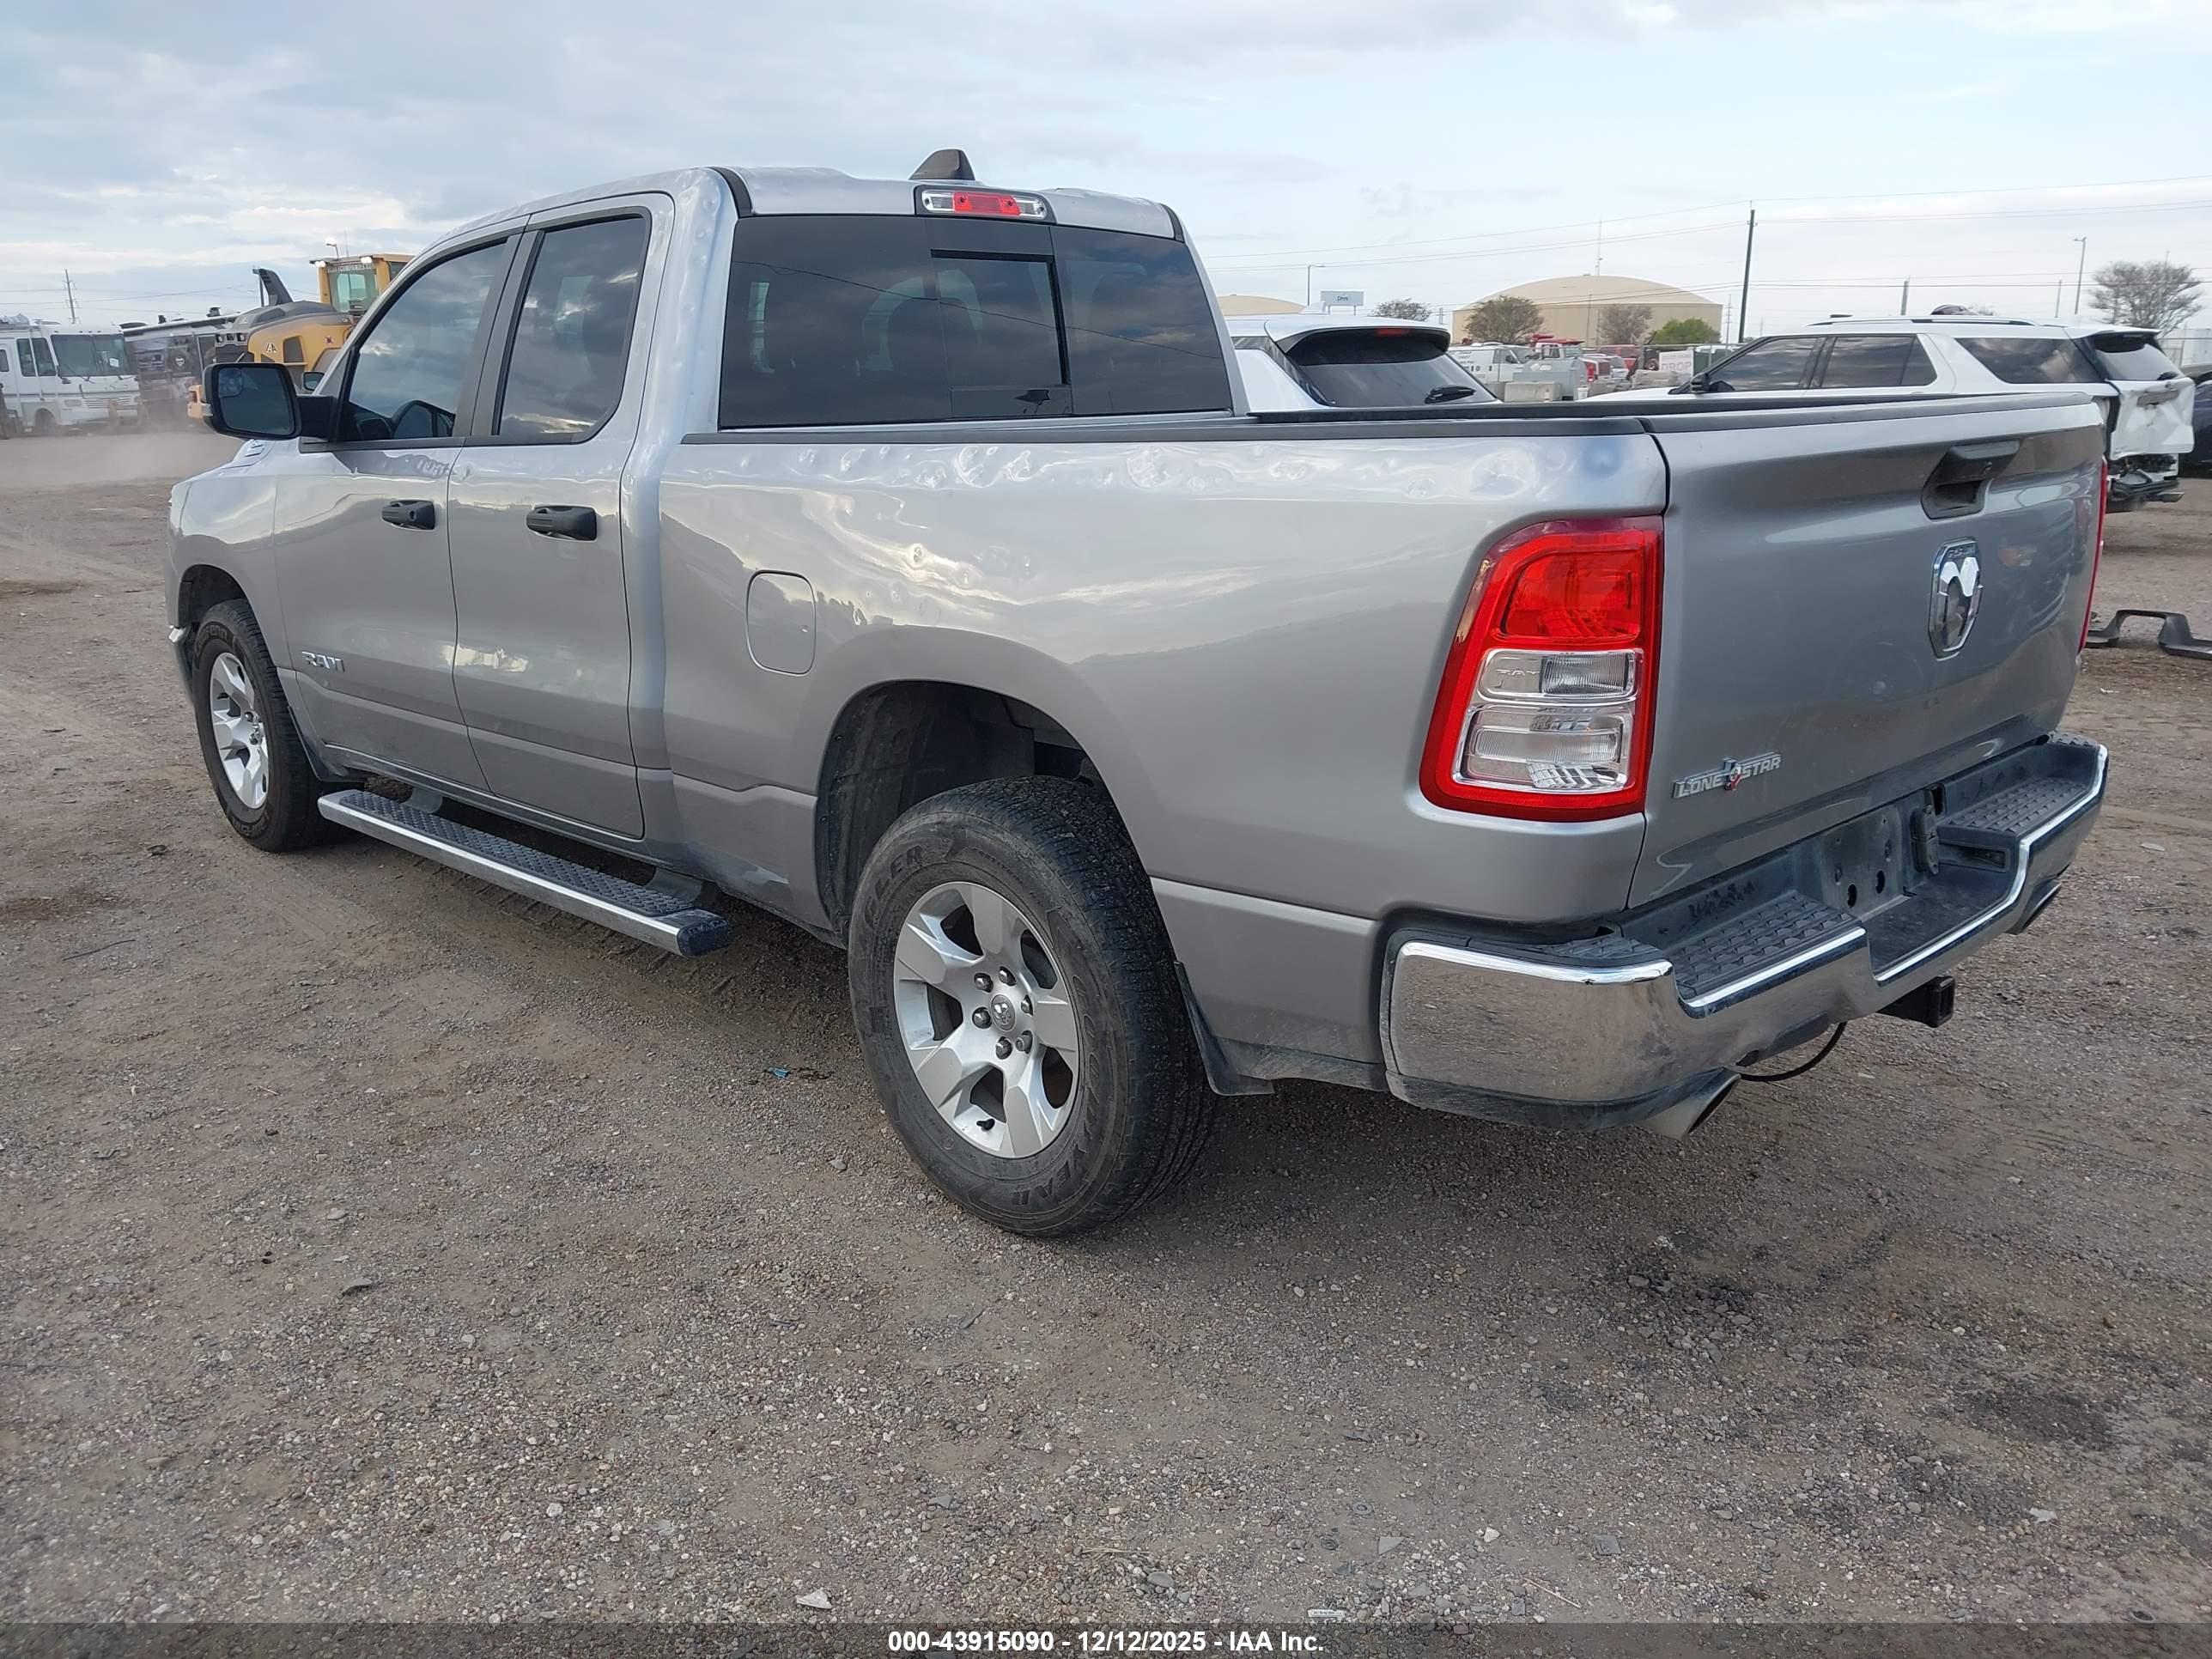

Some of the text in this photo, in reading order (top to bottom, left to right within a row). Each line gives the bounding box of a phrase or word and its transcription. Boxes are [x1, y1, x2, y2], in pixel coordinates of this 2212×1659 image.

[302, 651, 345, 673] RAM
[1675, 754, 1782, 798] LONE STAR
